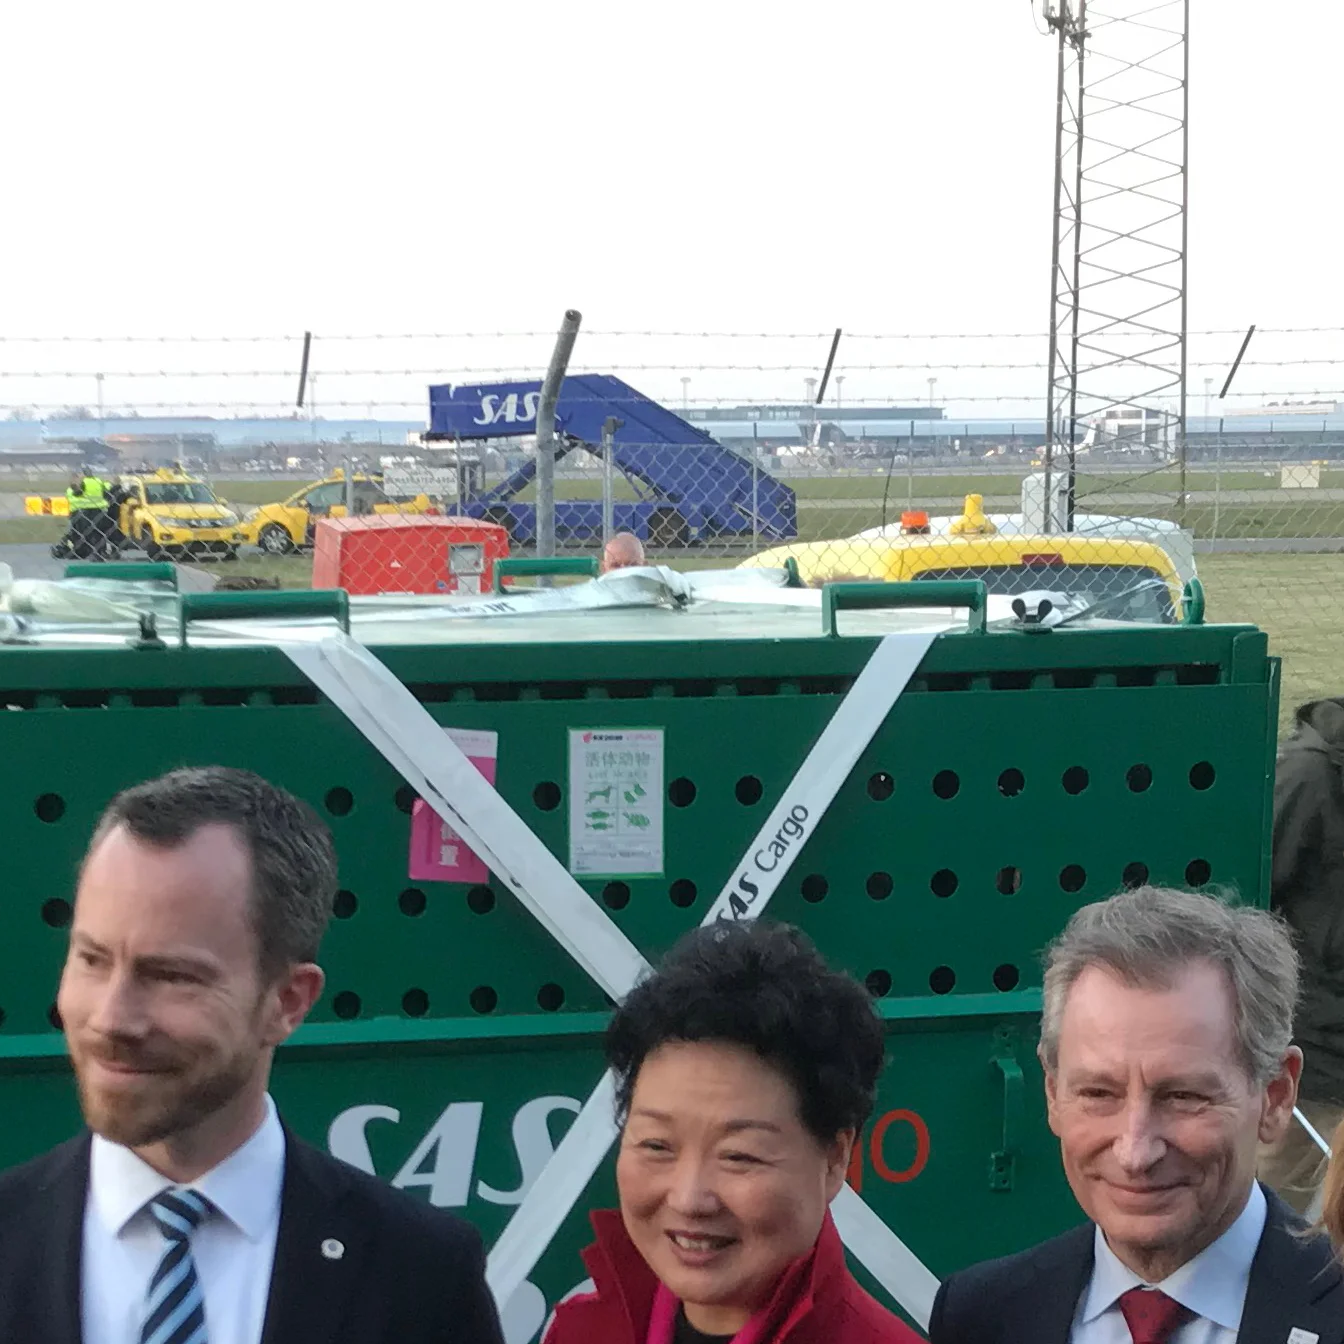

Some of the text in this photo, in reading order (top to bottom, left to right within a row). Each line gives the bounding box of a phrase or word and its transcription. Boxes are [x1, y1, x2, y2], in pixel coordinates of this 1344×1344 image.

[473, 392, 541, 424] SAS
[754, 804, 809, 873] Cargo
[327, 1095, 582, 1208] SAS
